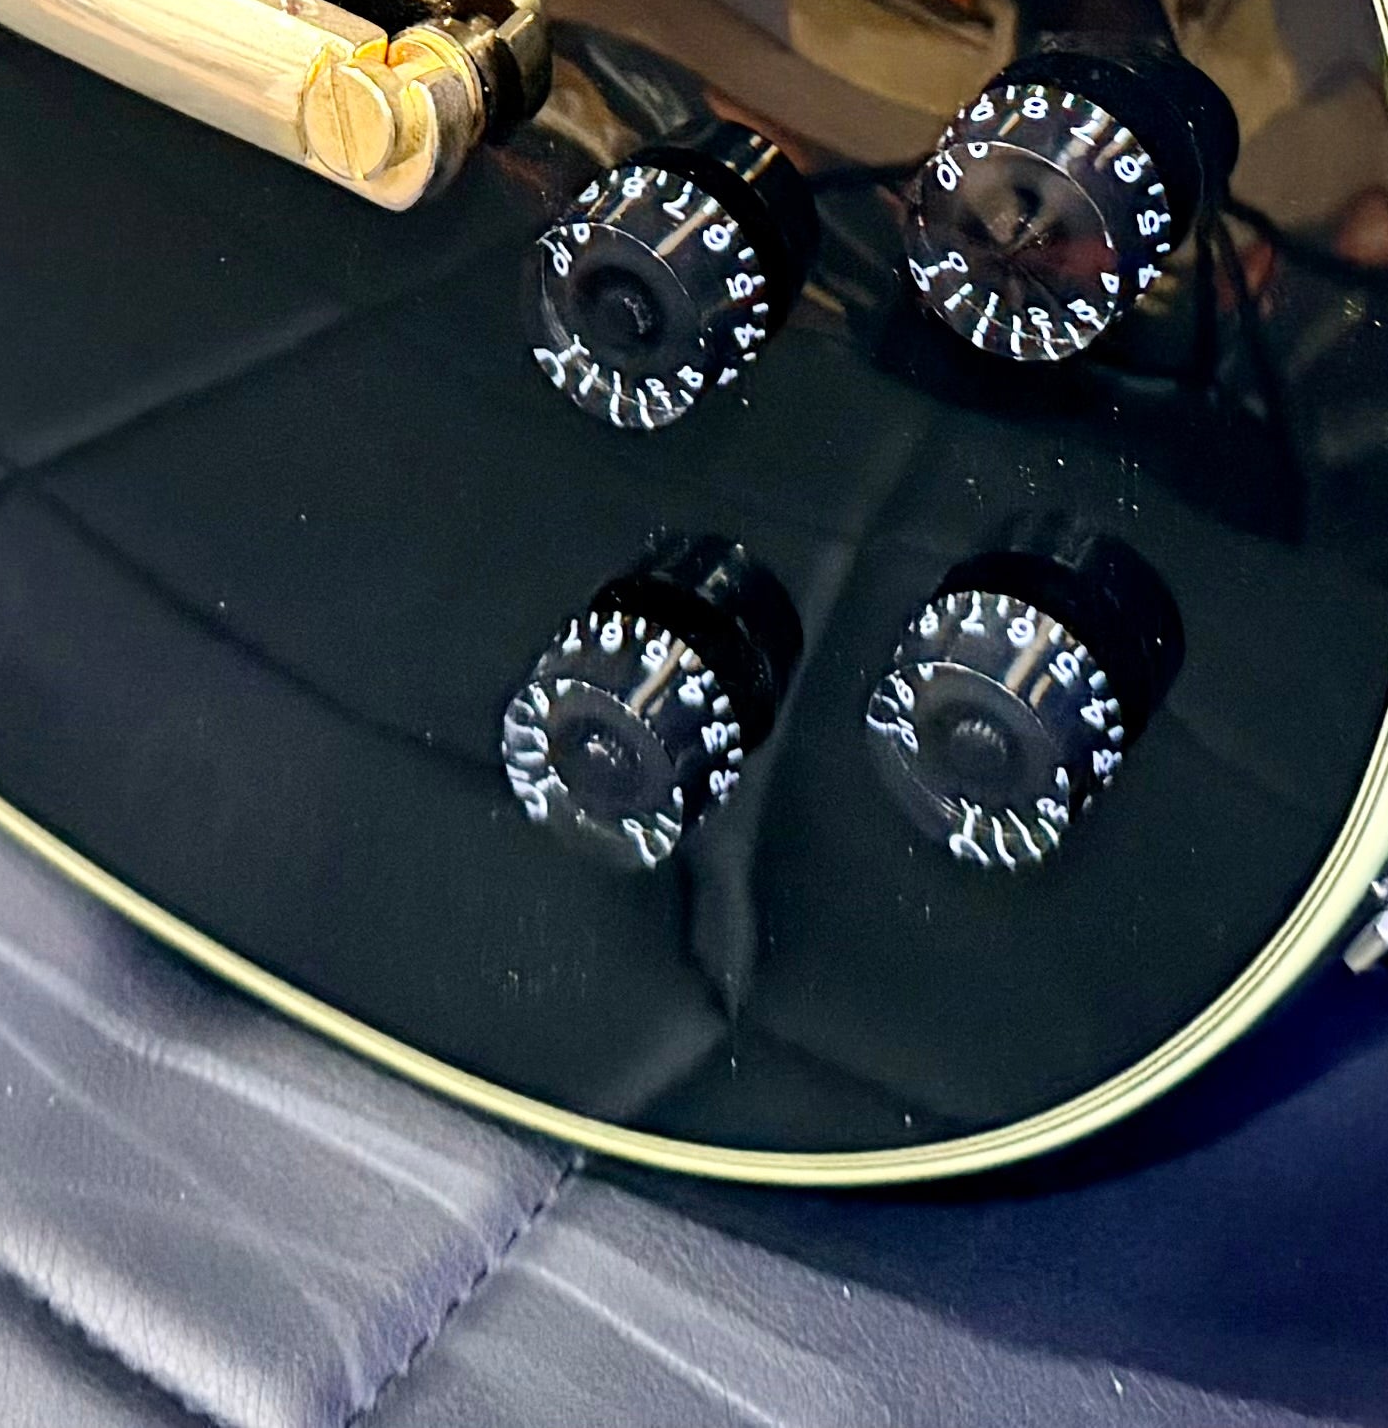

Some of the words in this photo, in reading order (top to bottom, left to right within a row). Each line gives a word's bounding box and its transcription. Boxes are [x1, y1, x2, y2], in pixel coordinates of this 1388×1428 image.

[1022, 97, 1048, 119] 8
[1070, 120, 1100, 145] 7
[1137, 209, 1161, 236] 5
[621, 175, 647, 199] 8
[726, 272, 754, 300] 5
[641, 639, 669, 672] 5
[701, 721, 728, 754] 3
[1048, 651, 1081, 689] 5
